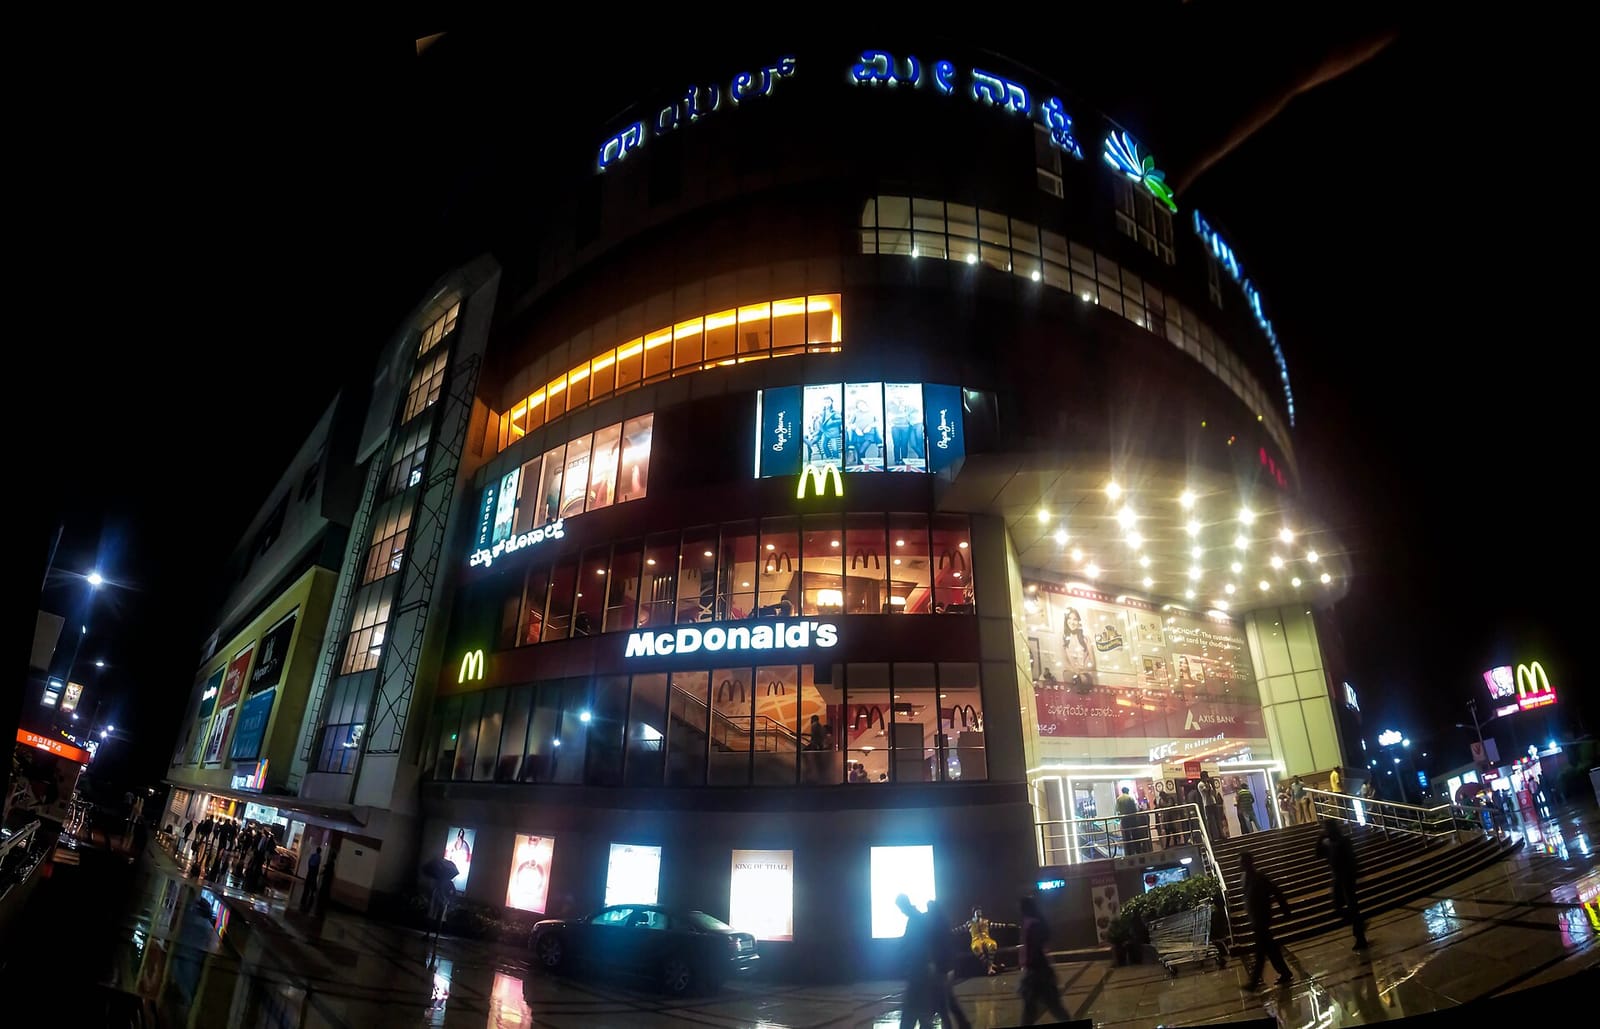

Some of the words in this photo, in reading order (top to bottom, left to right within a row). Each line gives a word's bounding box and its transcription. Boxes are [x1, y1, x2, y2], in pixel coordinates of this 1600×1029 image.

[624, 619, 838, 658] McDonald's
[1198, 714, 1215, 724] AXIS
[1216, 714, 1236, 725] BANK
[1148, 741, 1178, 762] KFC
[1184, 731, 1225, 752] Restaurant
